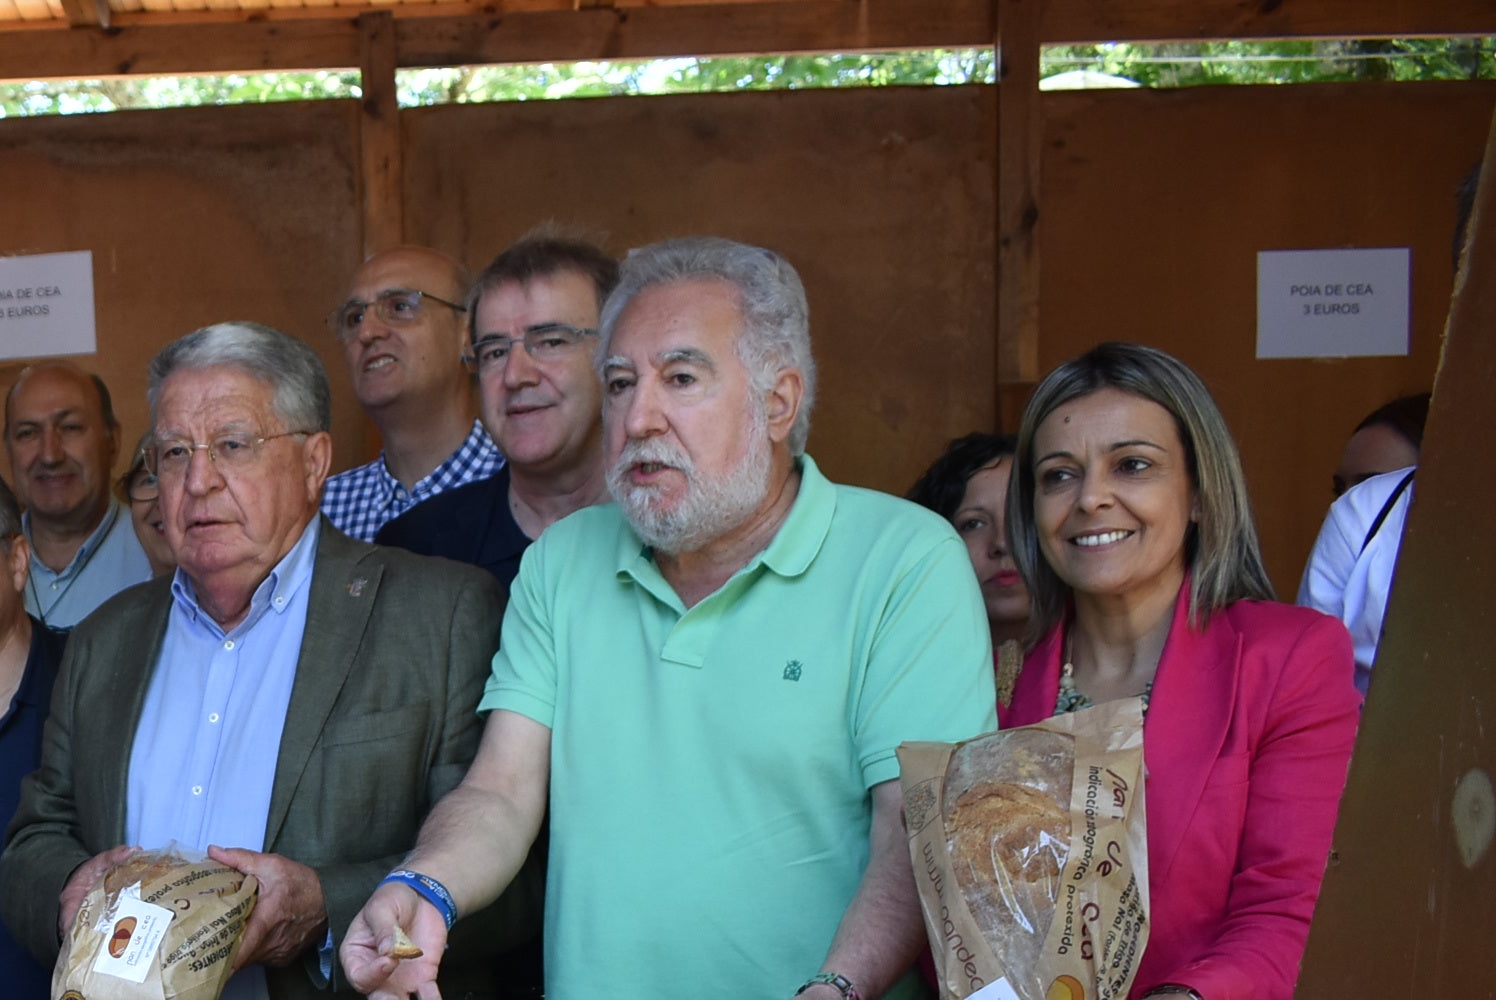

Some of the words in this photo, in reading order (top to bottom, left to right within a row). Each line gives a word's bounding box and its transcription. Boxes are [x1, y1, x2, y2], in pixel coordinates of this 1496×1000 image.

[17, 287, 33, 299] DE
[36, 286, 62, 298] CEA
[1290, 284, 1321, 297] POIA
[1324, 284, 1342, 296] DE
[1346, 283, 1374, 296] CEA
[7, 304, 51, 318] EUROS
[1303, 304, 1310, 316] 3
[1313, 303, 1361, 315] EUROS
[1096, 840, 1123, 877] de
[1057, 883, 1075, 955] protexida
